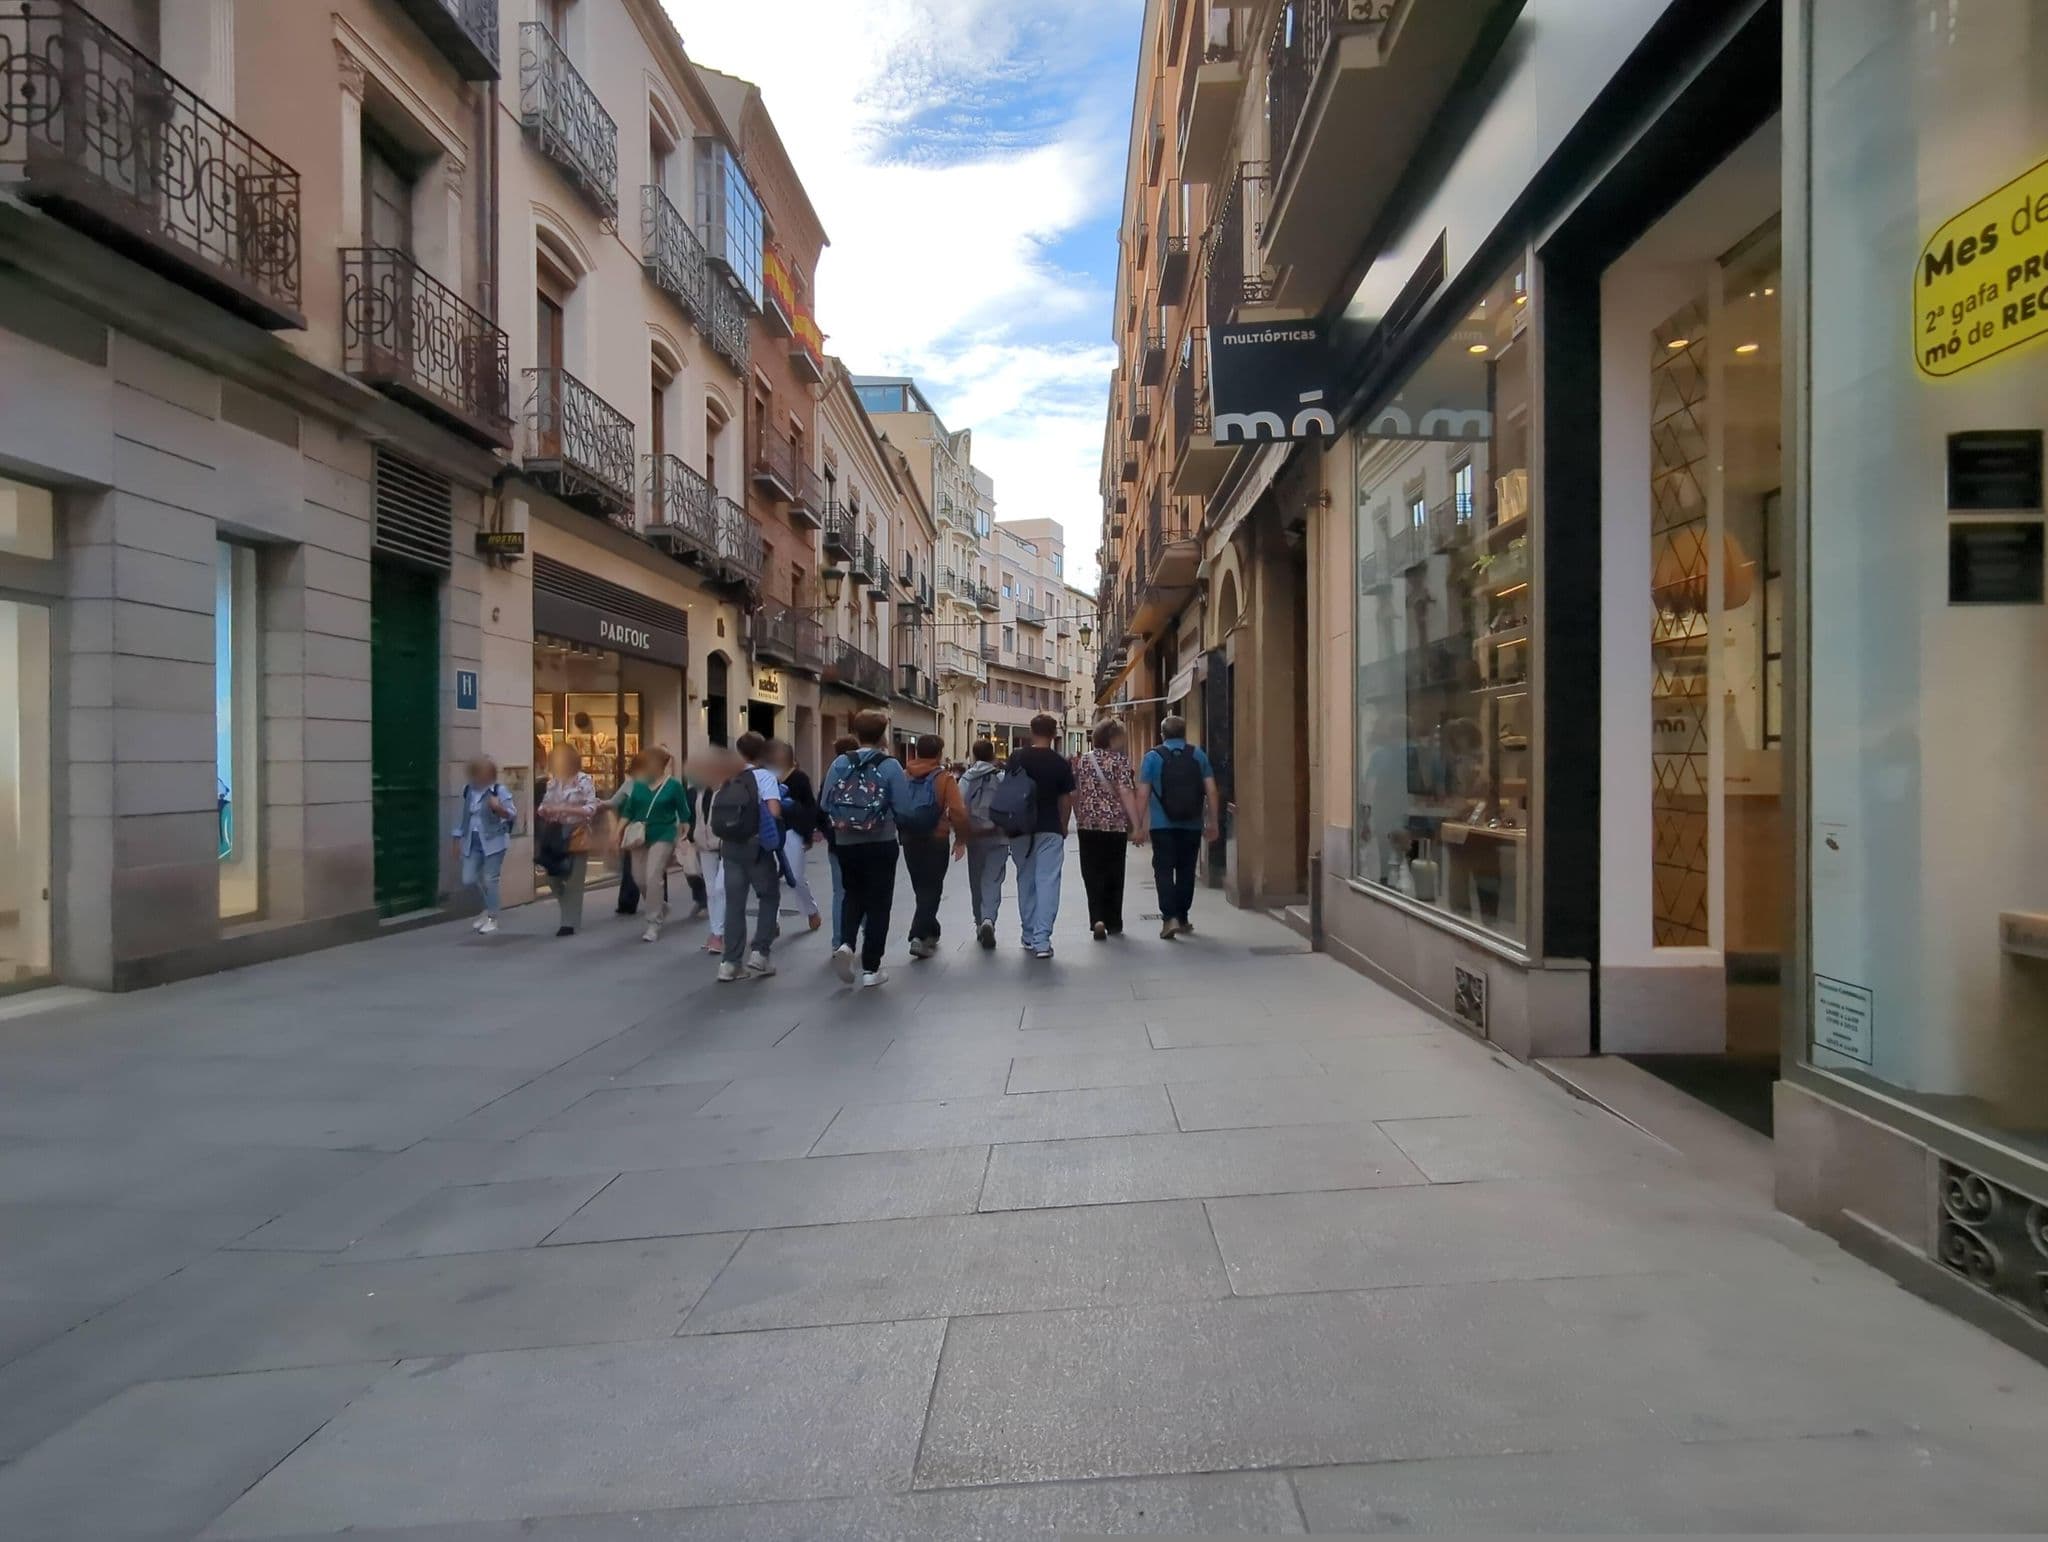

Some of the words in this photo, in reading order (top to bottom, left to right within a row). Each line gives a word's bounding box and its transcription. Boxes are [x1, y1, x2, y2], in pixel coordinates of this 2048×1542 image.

[1924, 222, 1999, 287] Mes
[2011, 193, 2048, 237] de
[1952, 281, 1999, 326] gafa
[1925, 329, 1961, 367] mó
[1968, 320, 1995, 346] de
[600, 620, 650, 649] PARFOIS
[462, 675, 472, 696] H
